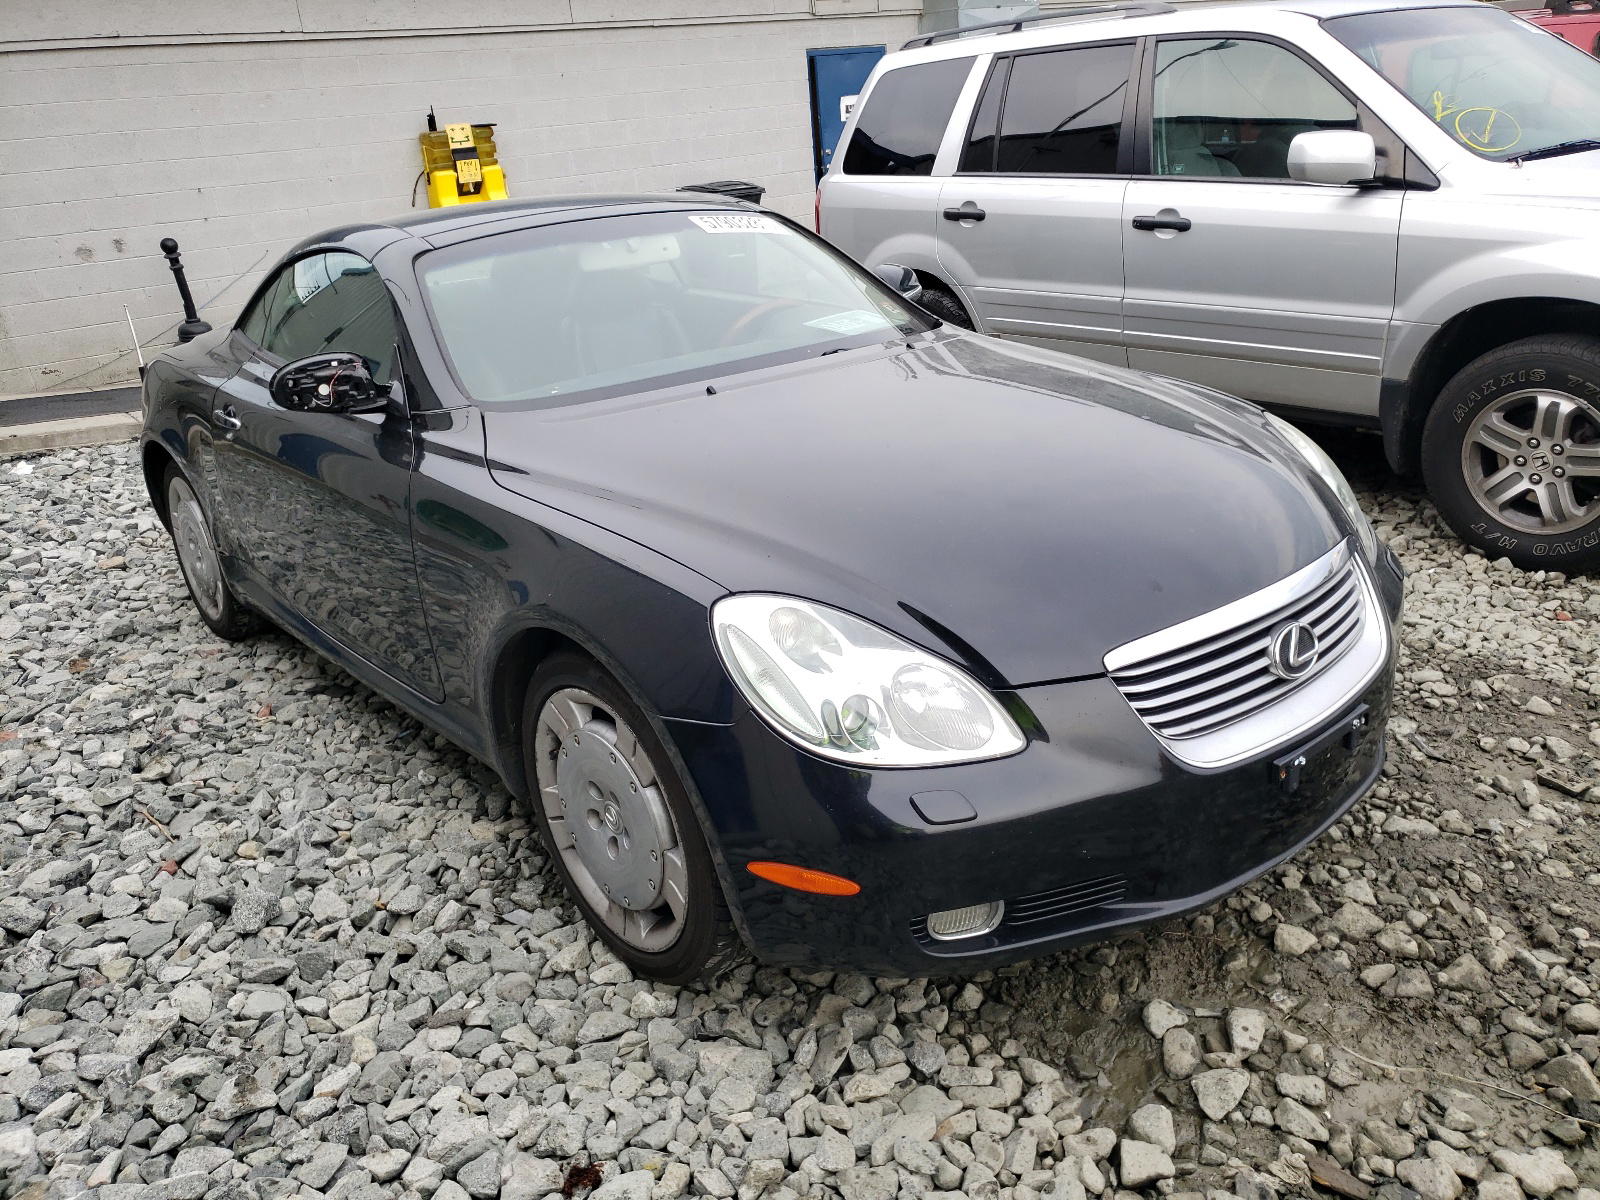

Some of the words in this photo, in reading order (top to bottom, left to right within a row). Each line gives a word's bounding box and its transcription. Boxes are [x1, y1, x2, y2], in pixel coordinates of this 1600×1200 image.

[1453, 369, 1546, 423] MAXXIS
[1567, 374, 1600, 403] 77
[1470, 523, 1518, 549] H/T
[1532, 527, 1600, 556] RAVO
